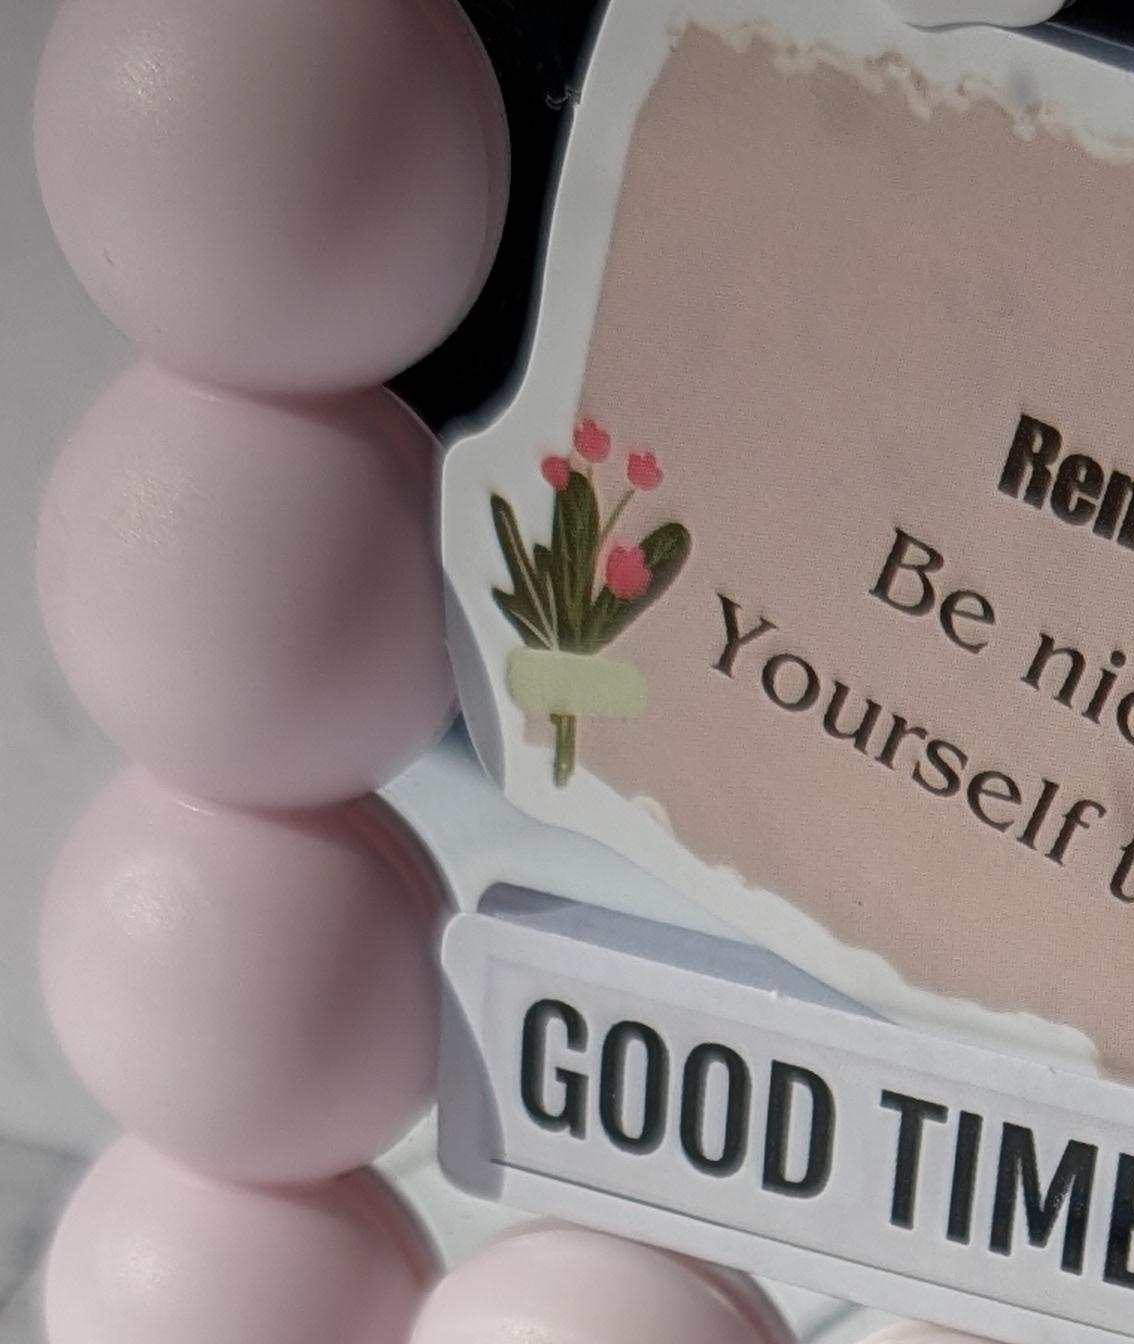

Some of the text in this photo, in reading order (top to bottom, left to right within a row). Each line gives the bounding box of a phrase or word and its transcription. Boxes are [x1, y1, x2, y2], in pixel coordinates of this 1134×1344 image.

[869, 526, 997, 654] Be
[711, 592, 1107, 867] Yourself
[518, 997, 836, 1199] GOOD
